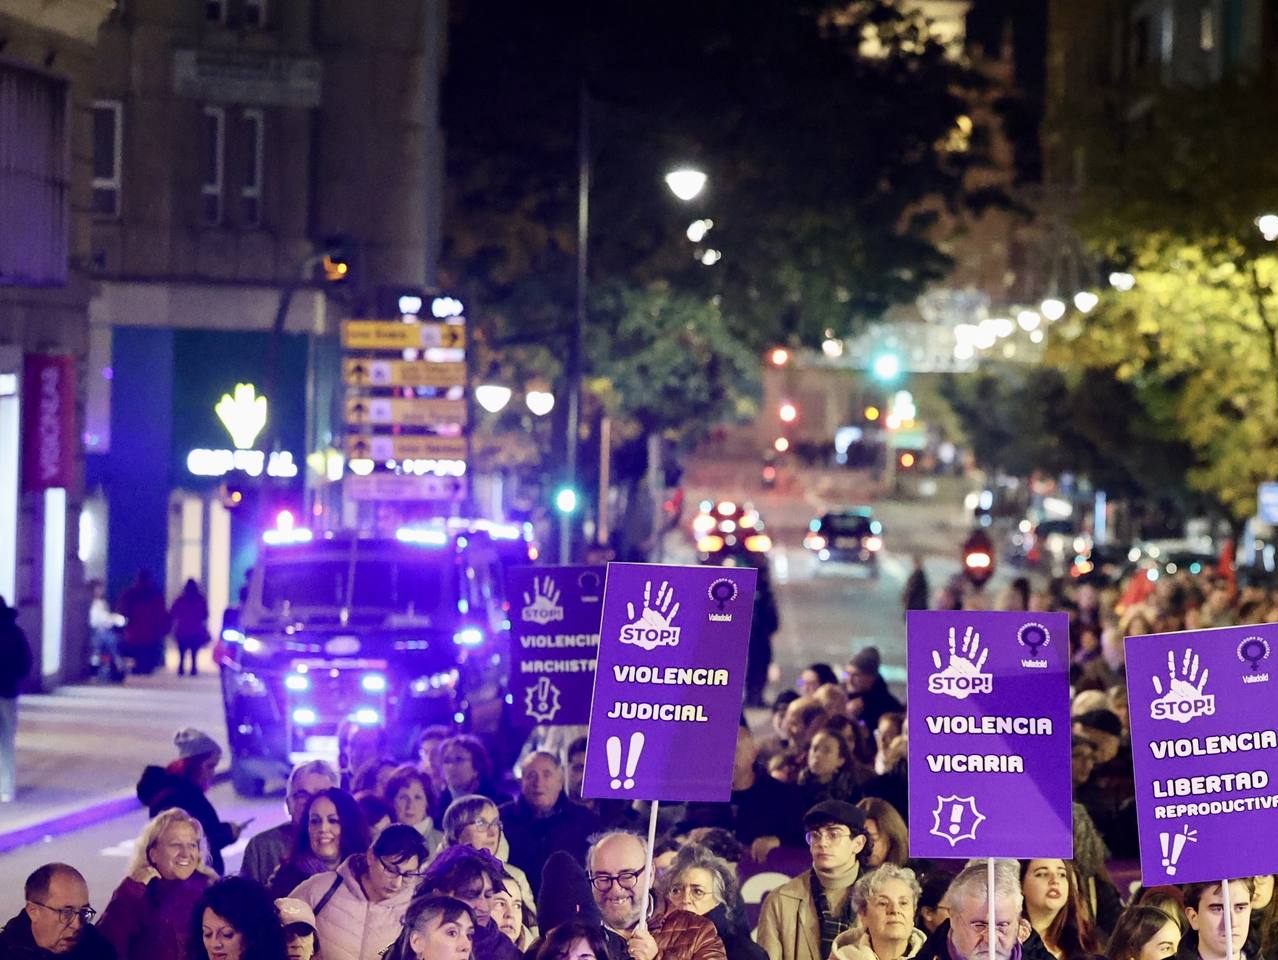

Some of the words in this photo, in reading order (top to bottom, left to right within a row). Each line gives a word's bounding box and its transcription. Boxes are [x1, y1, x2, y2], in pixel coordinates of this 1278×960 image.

[622, 627, 677, 643] STOP!
[612, 665, 729, 686] VIOLENCIA
[932, 676, 990, 691] STOP!
[1242, 672, 1269, 684] Valladolid
[607, 701, 708, 722] JUDICIAL
[1154, 698, 1212, 716] STOP!
[926, 716, 1053, 736] VIOLENCIA
[1149, 730, 1278, 760] VIOLENCIA
[926, 754, 1024, 773] VICARIA
[1153, 770, 1269, 798] LIBERTAD
